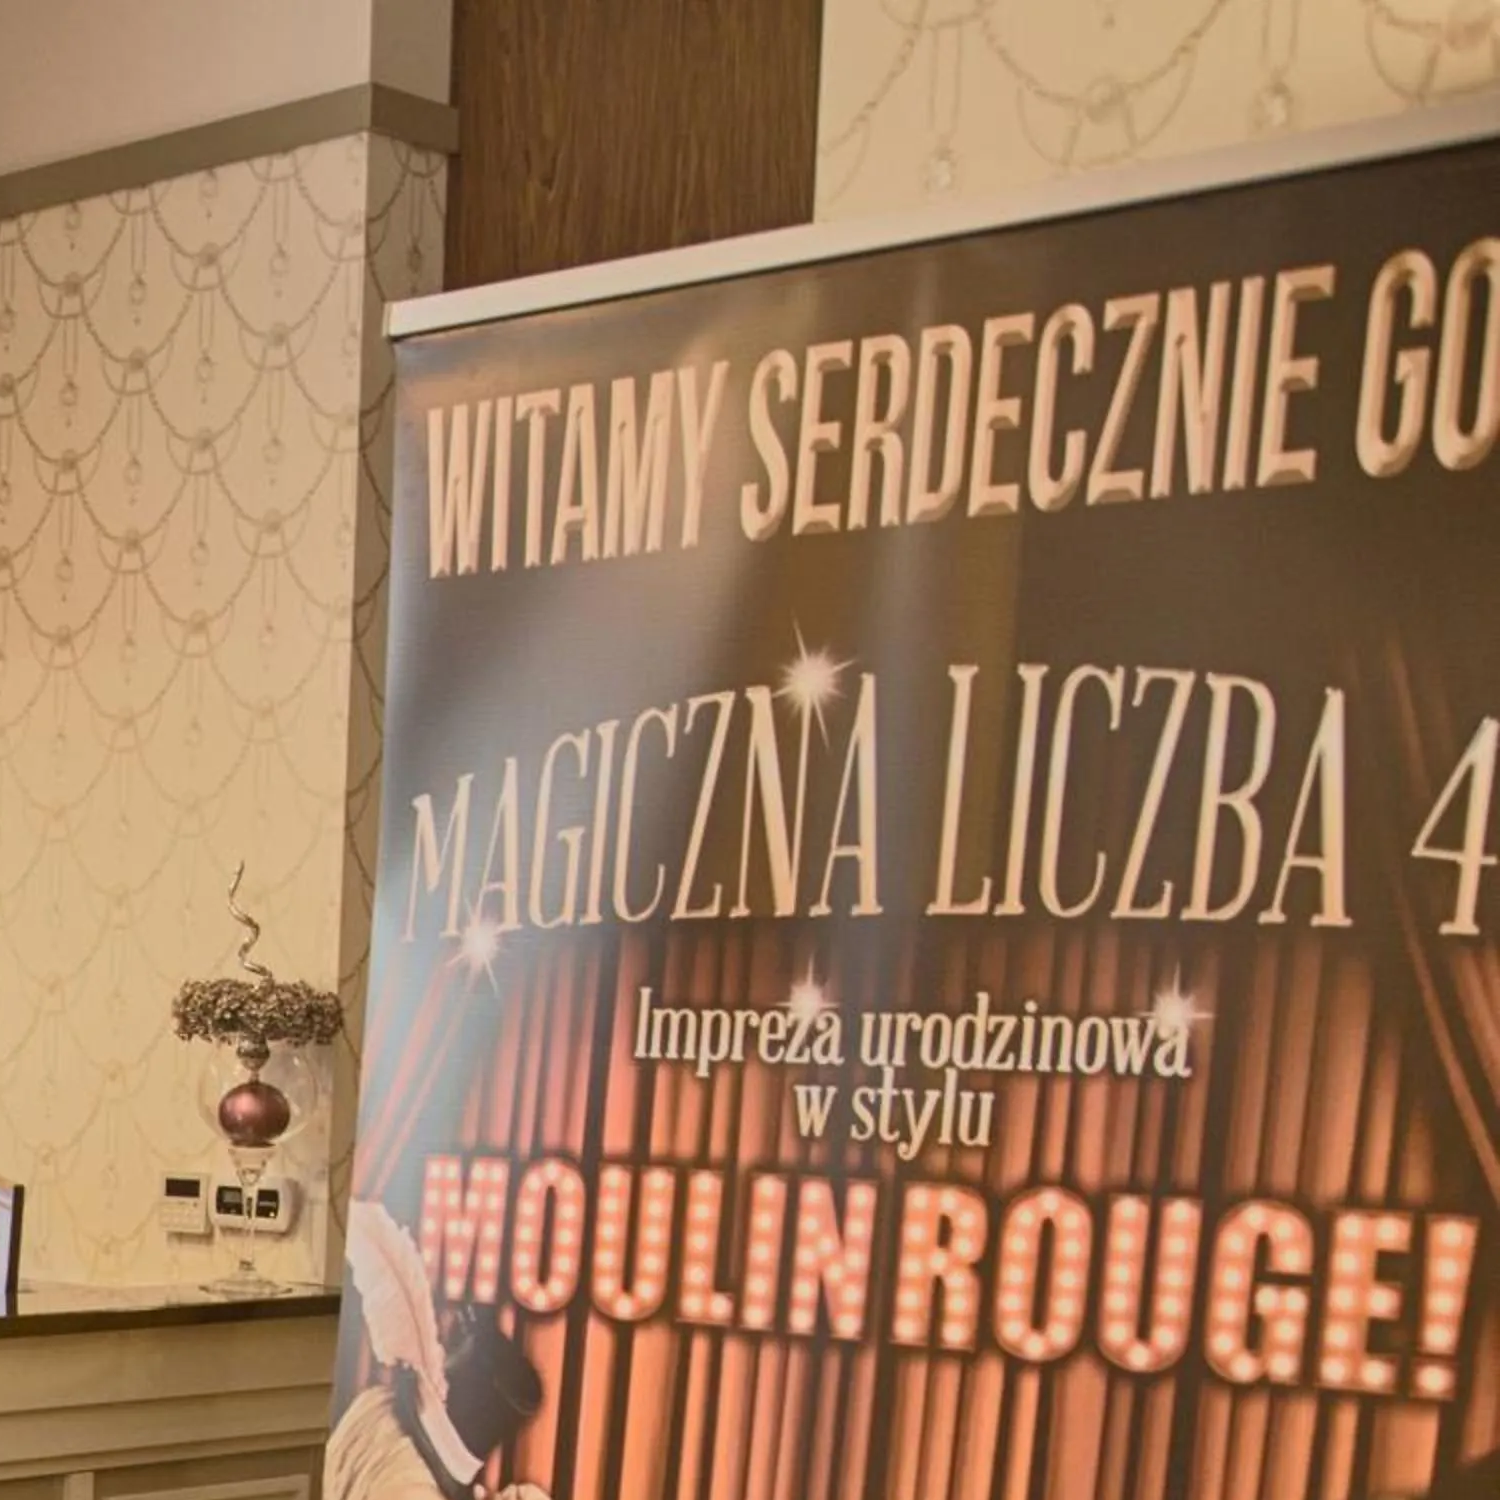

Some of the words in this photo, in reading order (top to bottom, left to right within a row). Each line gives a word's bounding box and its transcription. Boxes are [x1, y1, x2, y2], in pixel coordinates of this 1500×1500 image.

[426, 360, 730, 578] WITAMY
[740, 264, 1336, 542] SERDECZNIE
[407, 674, 882, 941] MAGICZNA
[926, 664, 1352, 927] LICZBA
[1410, 715, 1500, 935] 4
[633, 986, 844, 1078] Impreza
[858, 991, 1192, 1078] urodzinowa
[794, 1082, 838, 1138] w
[850, 1066, 995, 1160] stylu
[418, 1153, 878, 1342] MOULIN
[892, 1180, 1479, 1398] ROUGE!
